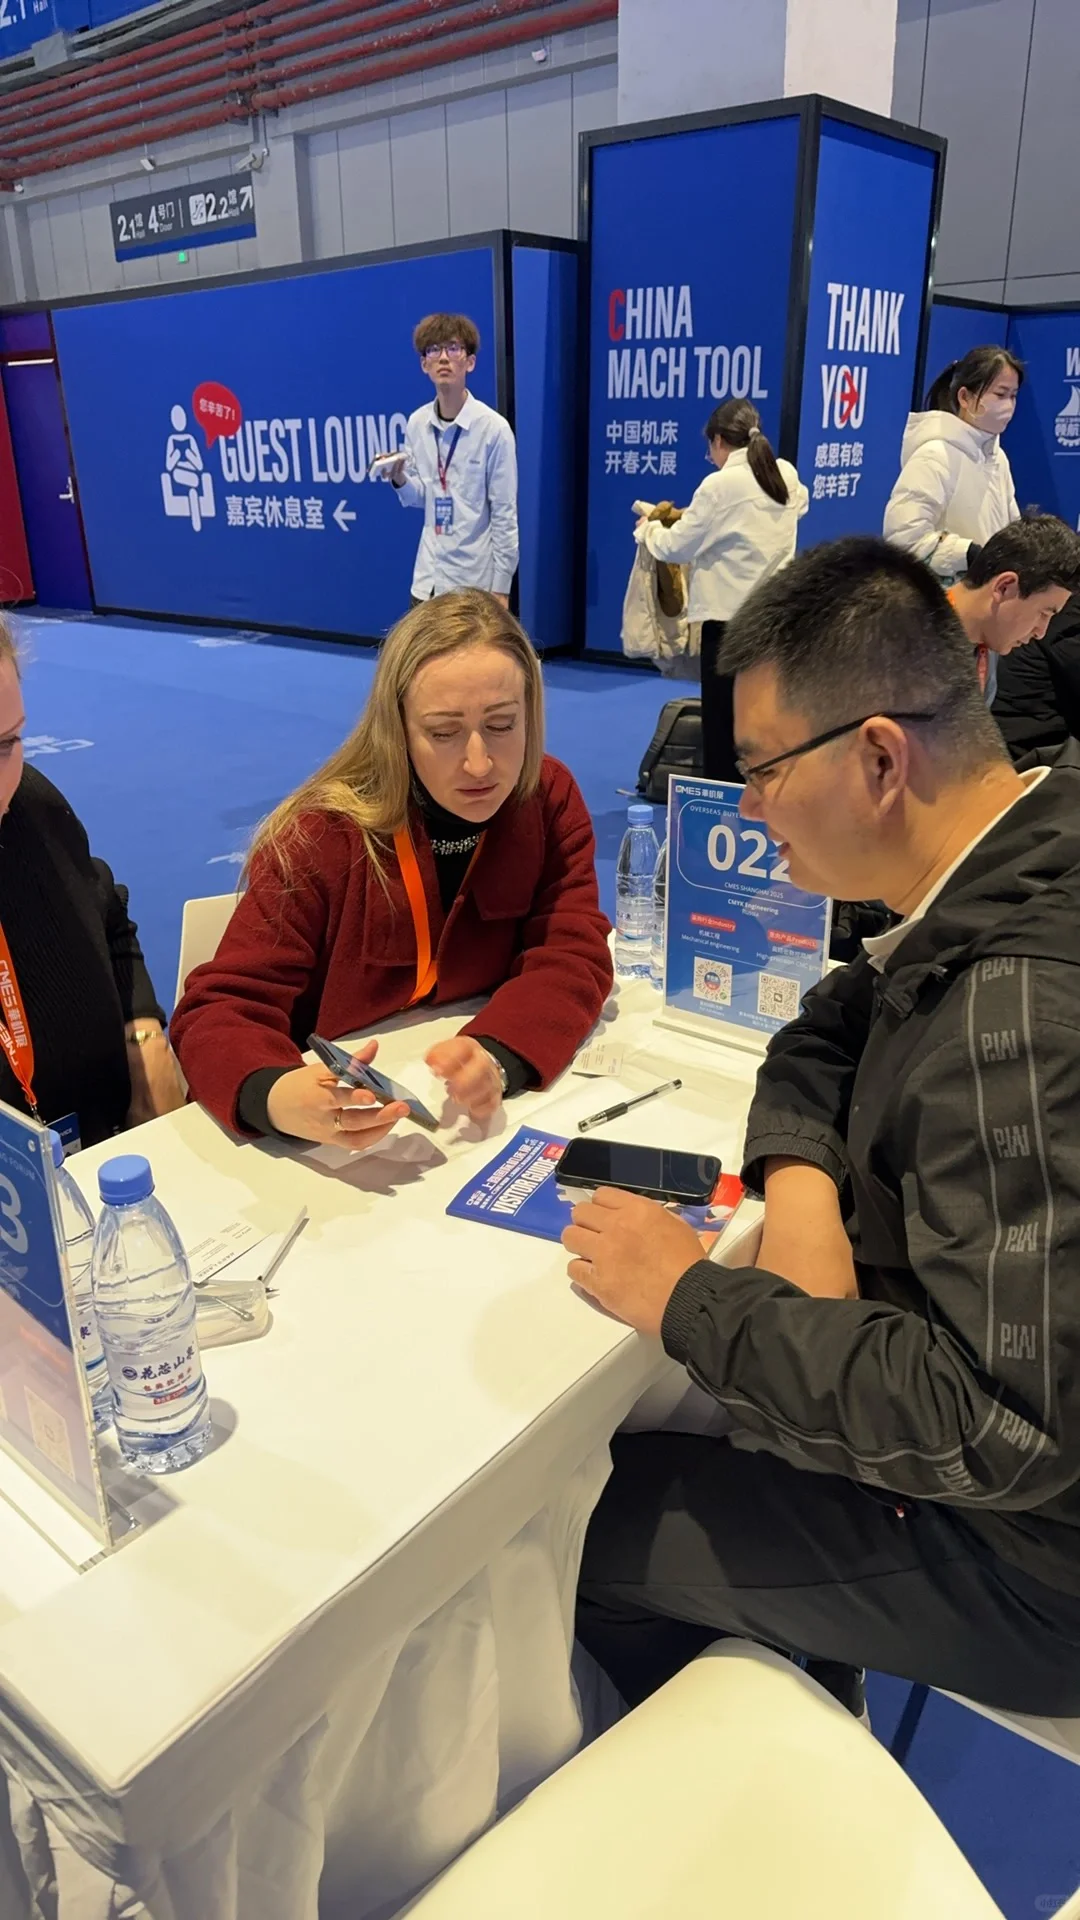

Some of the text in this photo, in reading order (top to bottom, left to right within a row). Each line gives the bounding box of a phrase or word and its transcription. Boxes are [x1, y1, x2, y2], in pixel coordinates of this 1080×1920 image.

[148, 206, 159, 233] 4
[158, 202, 175, 220] 号门
[205, 193, 230, 223] 2.2
[159, 222, 173, 233] Door
[608, 285, 693, 342] CHINA
[827, 282, 905, 356] THANK
[607, 345, 768, 399] MACH TOOL
[821, 364, 868, 430] YOU
[606, 419, 679, 446] 中国机床
[218, 418, 302, 484] GUEST
[604, 449, 677, 477] 开春大展
[814, 441, 864, 468] 感恩有您
[812, 473, 862, 500] 您辛苦了
[225, 494, 326, 530] 嘉宾休息室
[689, 804, 742, 819] OVERSEAS BUYE
[724, 882, 784, 899] CMES SHANGHAI 2025
[744, 901, 779, 916] Engineering
[681, 933, 740, 953] Mechanical engineering
[490, 1178, 539, 1214] VISITOR
[520, 1156, 559, 1184] GUIDE
